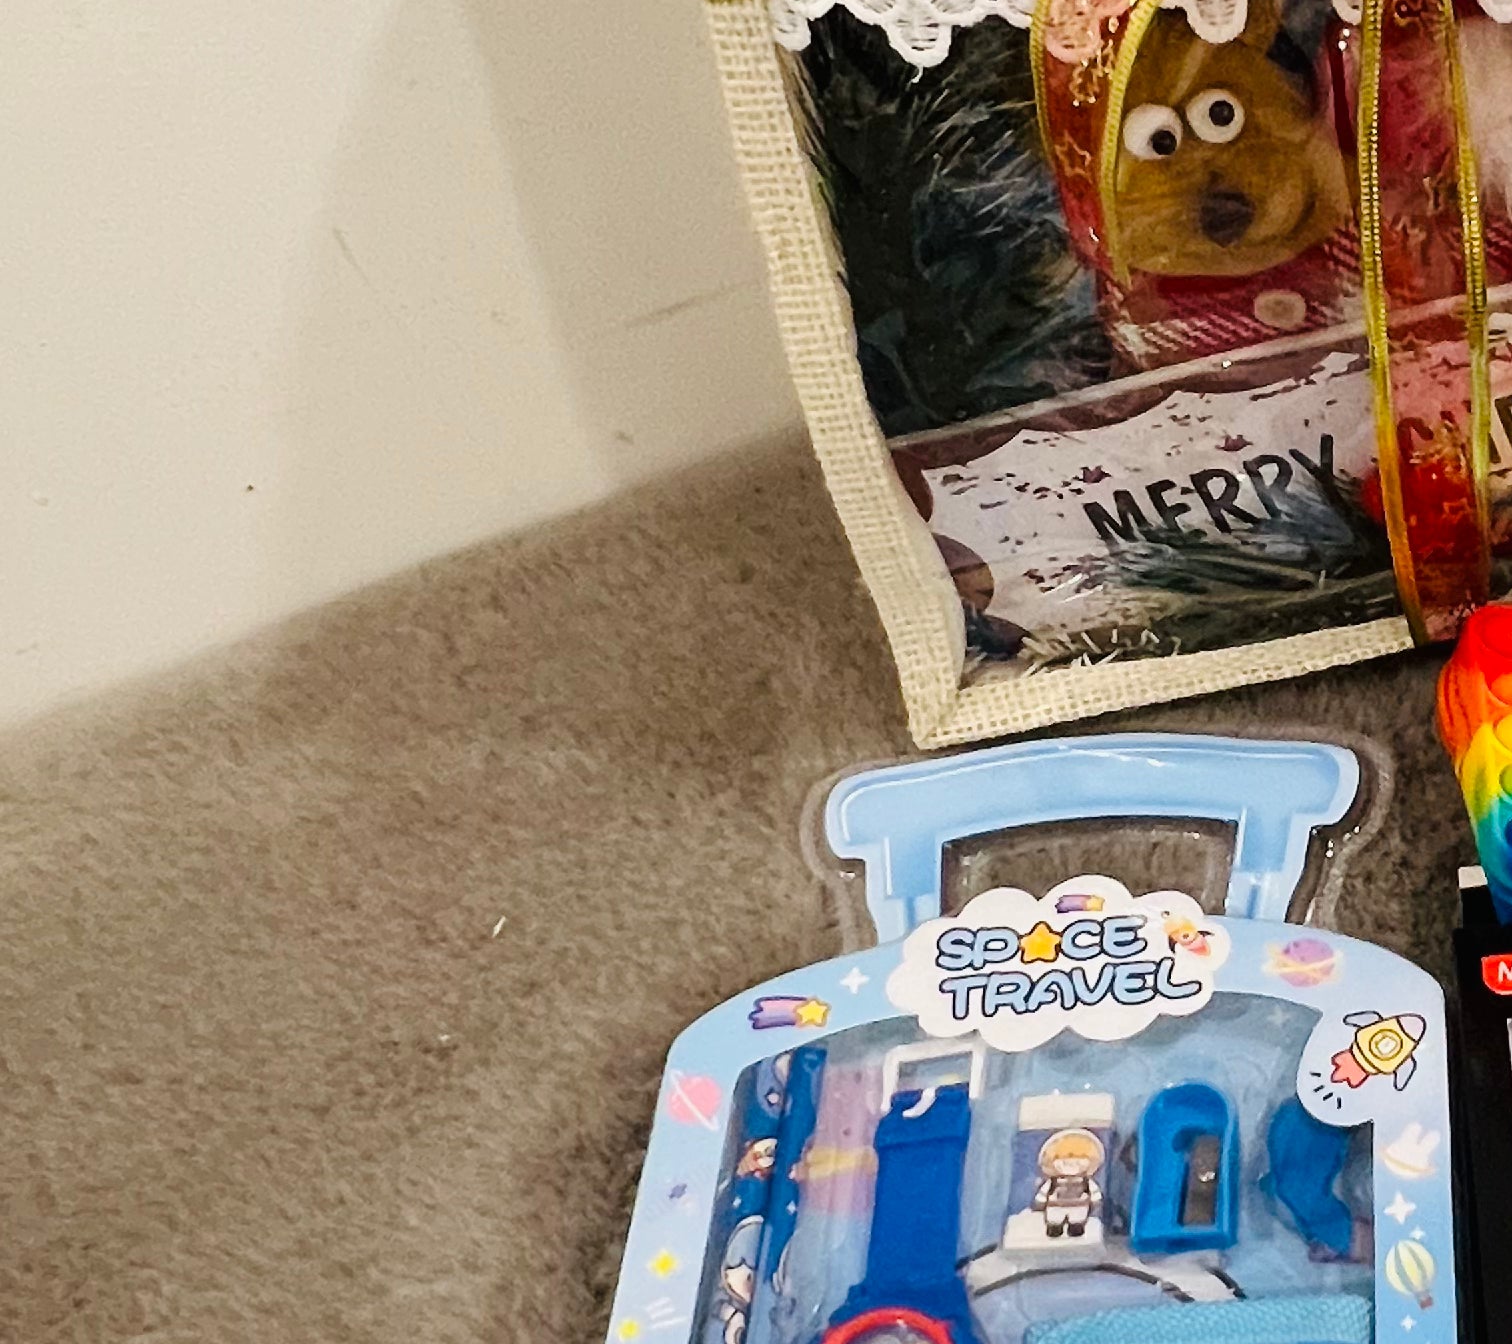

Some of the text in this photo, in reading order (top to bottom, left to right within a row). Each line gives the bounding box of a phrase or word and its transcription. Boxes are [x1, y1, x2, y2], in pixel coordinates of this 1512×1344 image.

[1083, 433, 1352, 549] MERRY
[935, 915, 1148, 970] SPCE
[939, 957, 1202, 1020] TRAVEL
